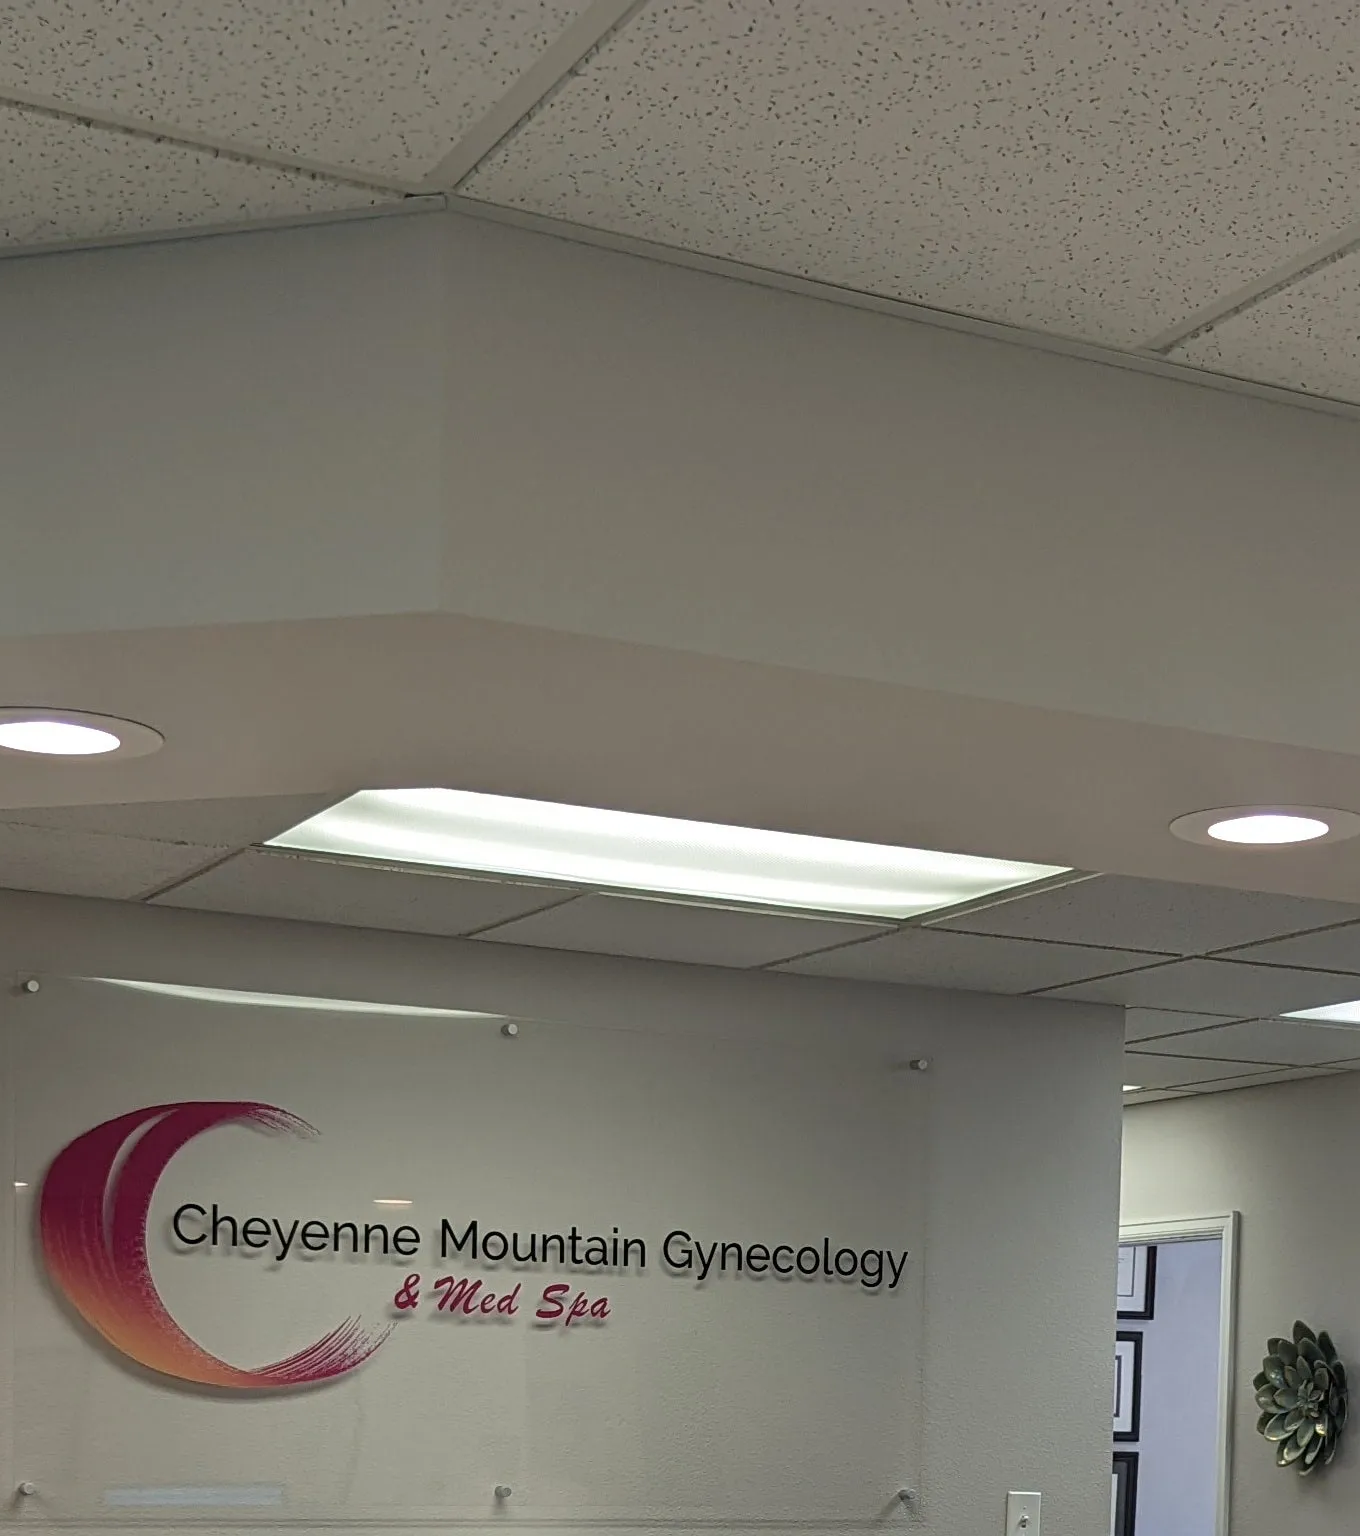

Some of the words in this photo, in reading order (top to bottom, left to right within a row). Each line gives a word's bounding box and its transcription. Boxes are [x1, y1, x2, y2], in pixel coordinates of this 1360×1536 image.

[173, 1203, 421, 1262] Cheyenne
[440, 1218, 647, 1269] Mountain
[662, 1230, 909, 1289] Gynecology
[394, 1273, 420, 1310] &
[434, 1275, 523, 1315] Med
[535, 1283, 612, 1327] Spa
